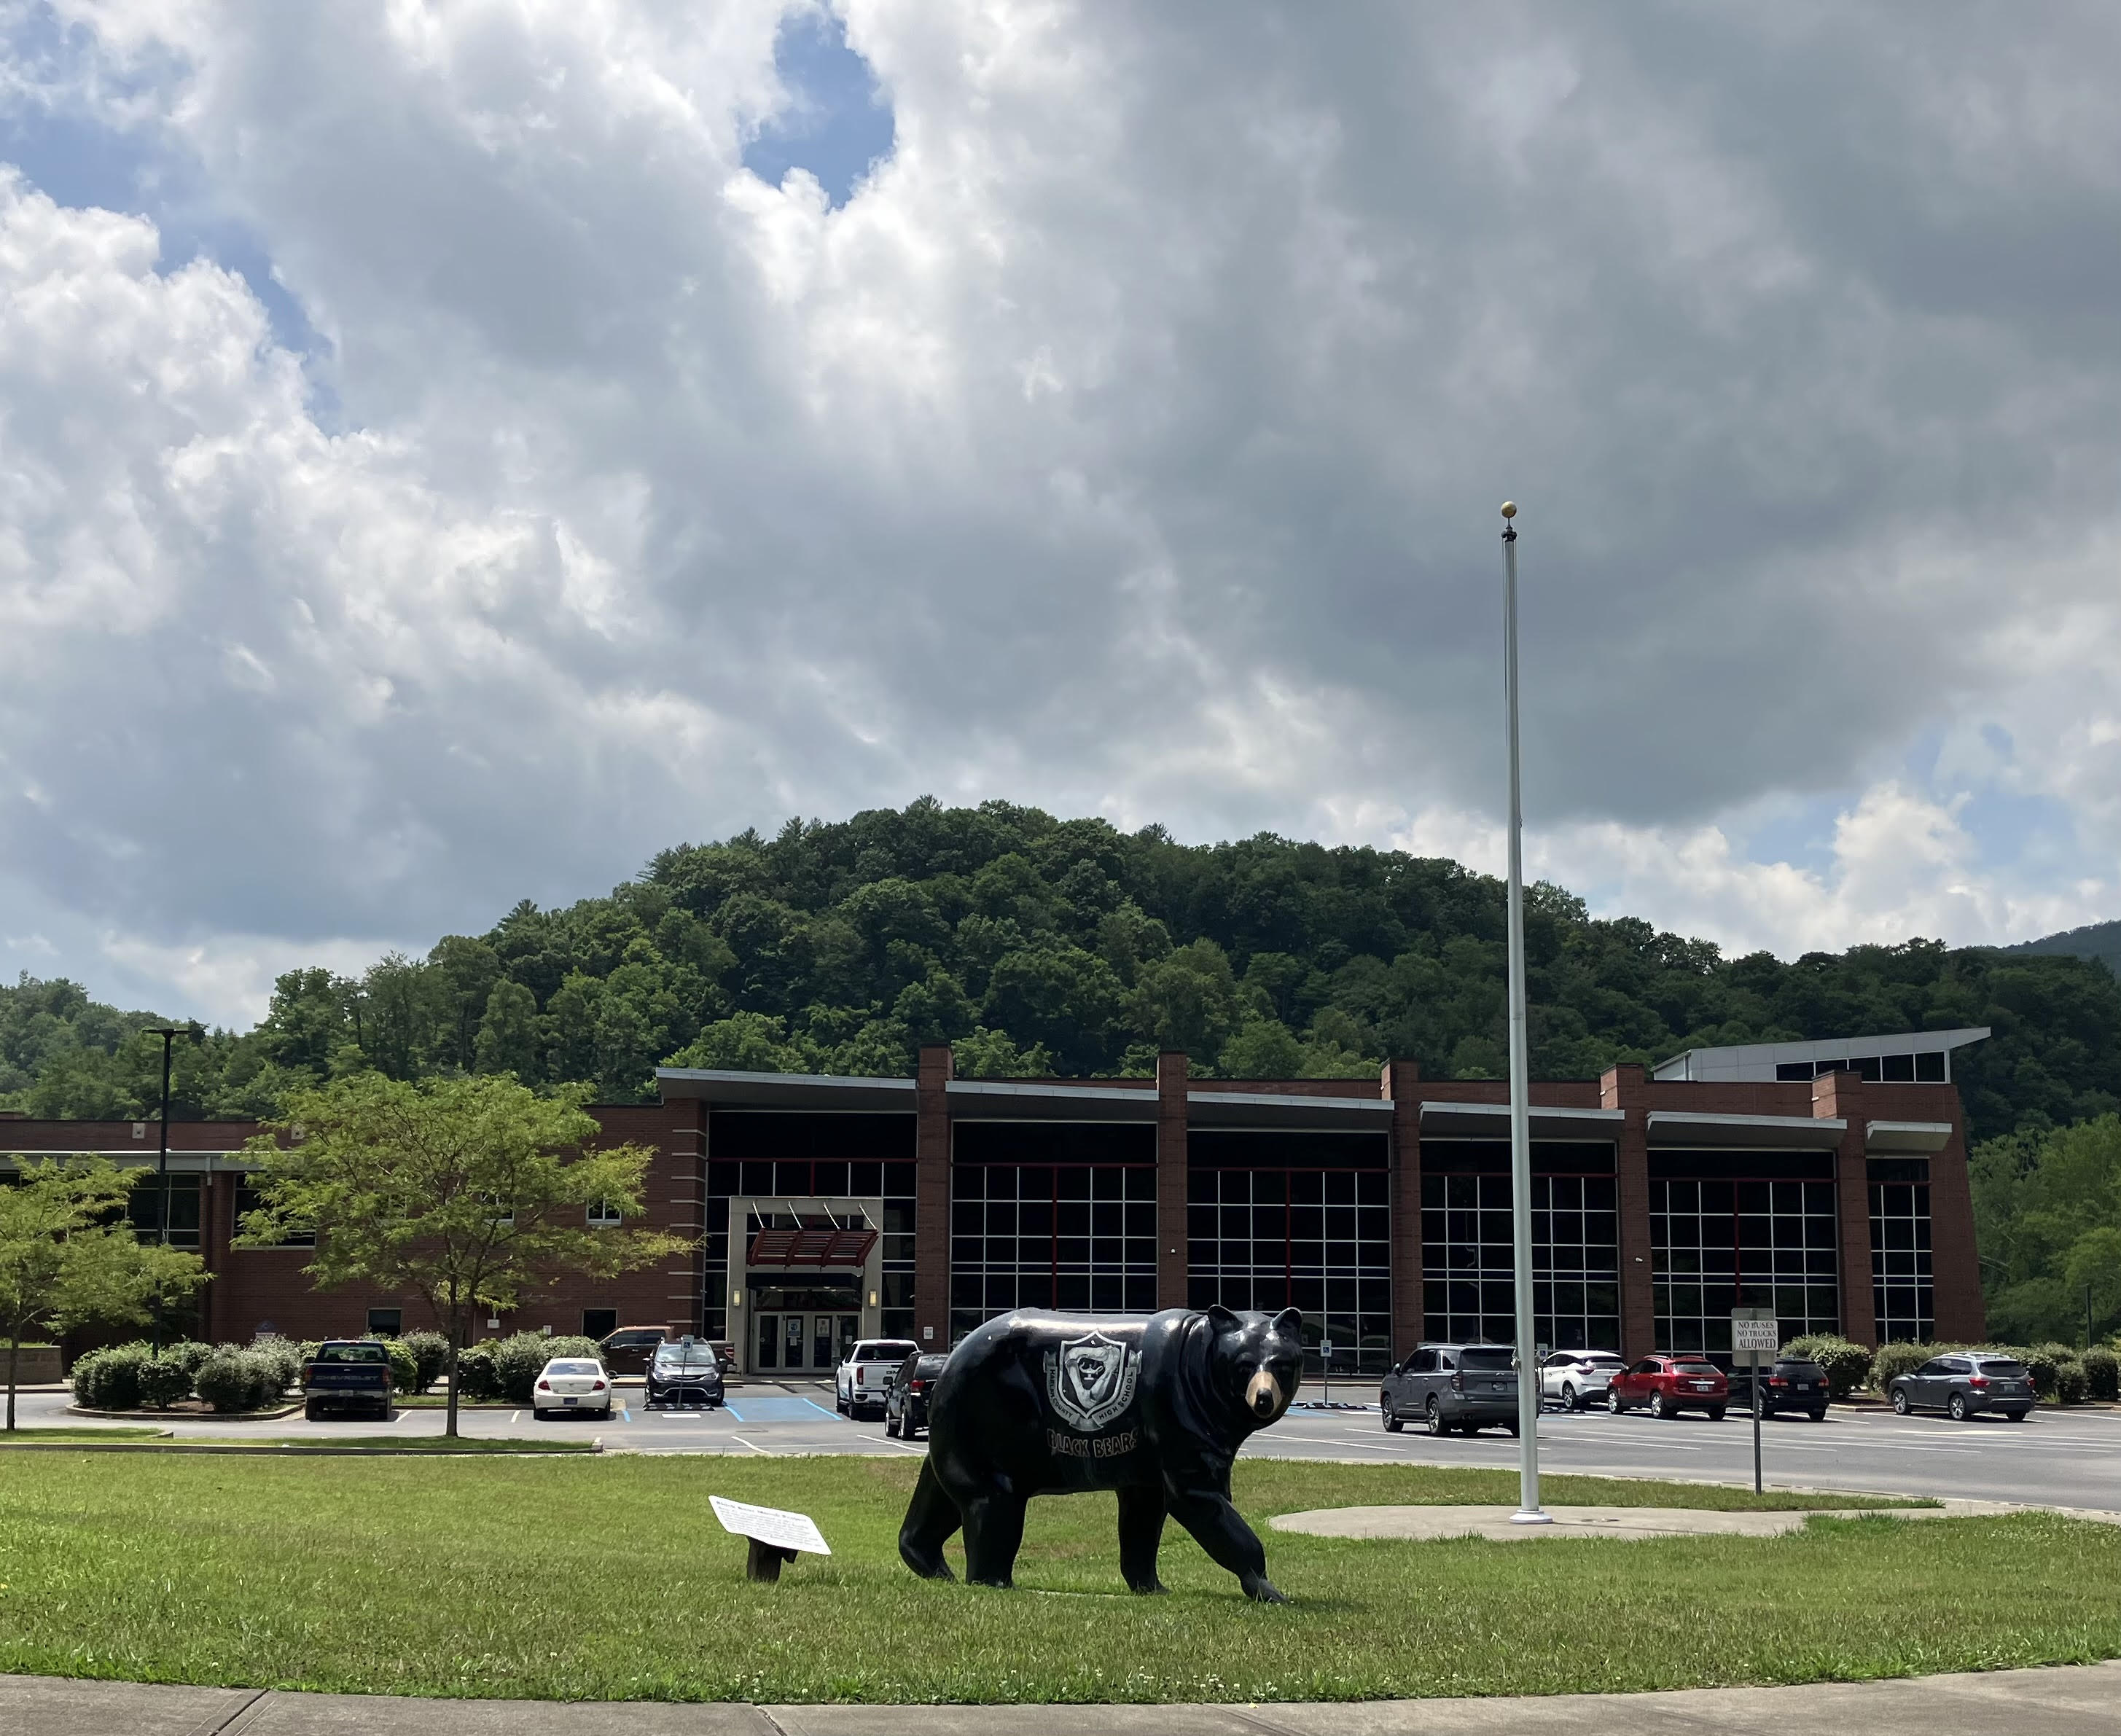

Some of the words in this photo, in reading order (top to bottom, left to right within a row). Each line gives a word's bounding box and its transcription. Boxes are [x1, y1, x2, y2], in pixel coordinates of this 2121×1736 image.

[1739, 1339, 1776, 1348] ALLOWED
[1053, 1397, 1074, 1418] COUNTY
[1098, 1406, 1118, 1420] HIGH
[1118, 1371, 1133, 1407] SCHOOL
[1047, 1428, 1090, 1457] BLACK
[1093, 1428, 1138, 1458] BEARS
